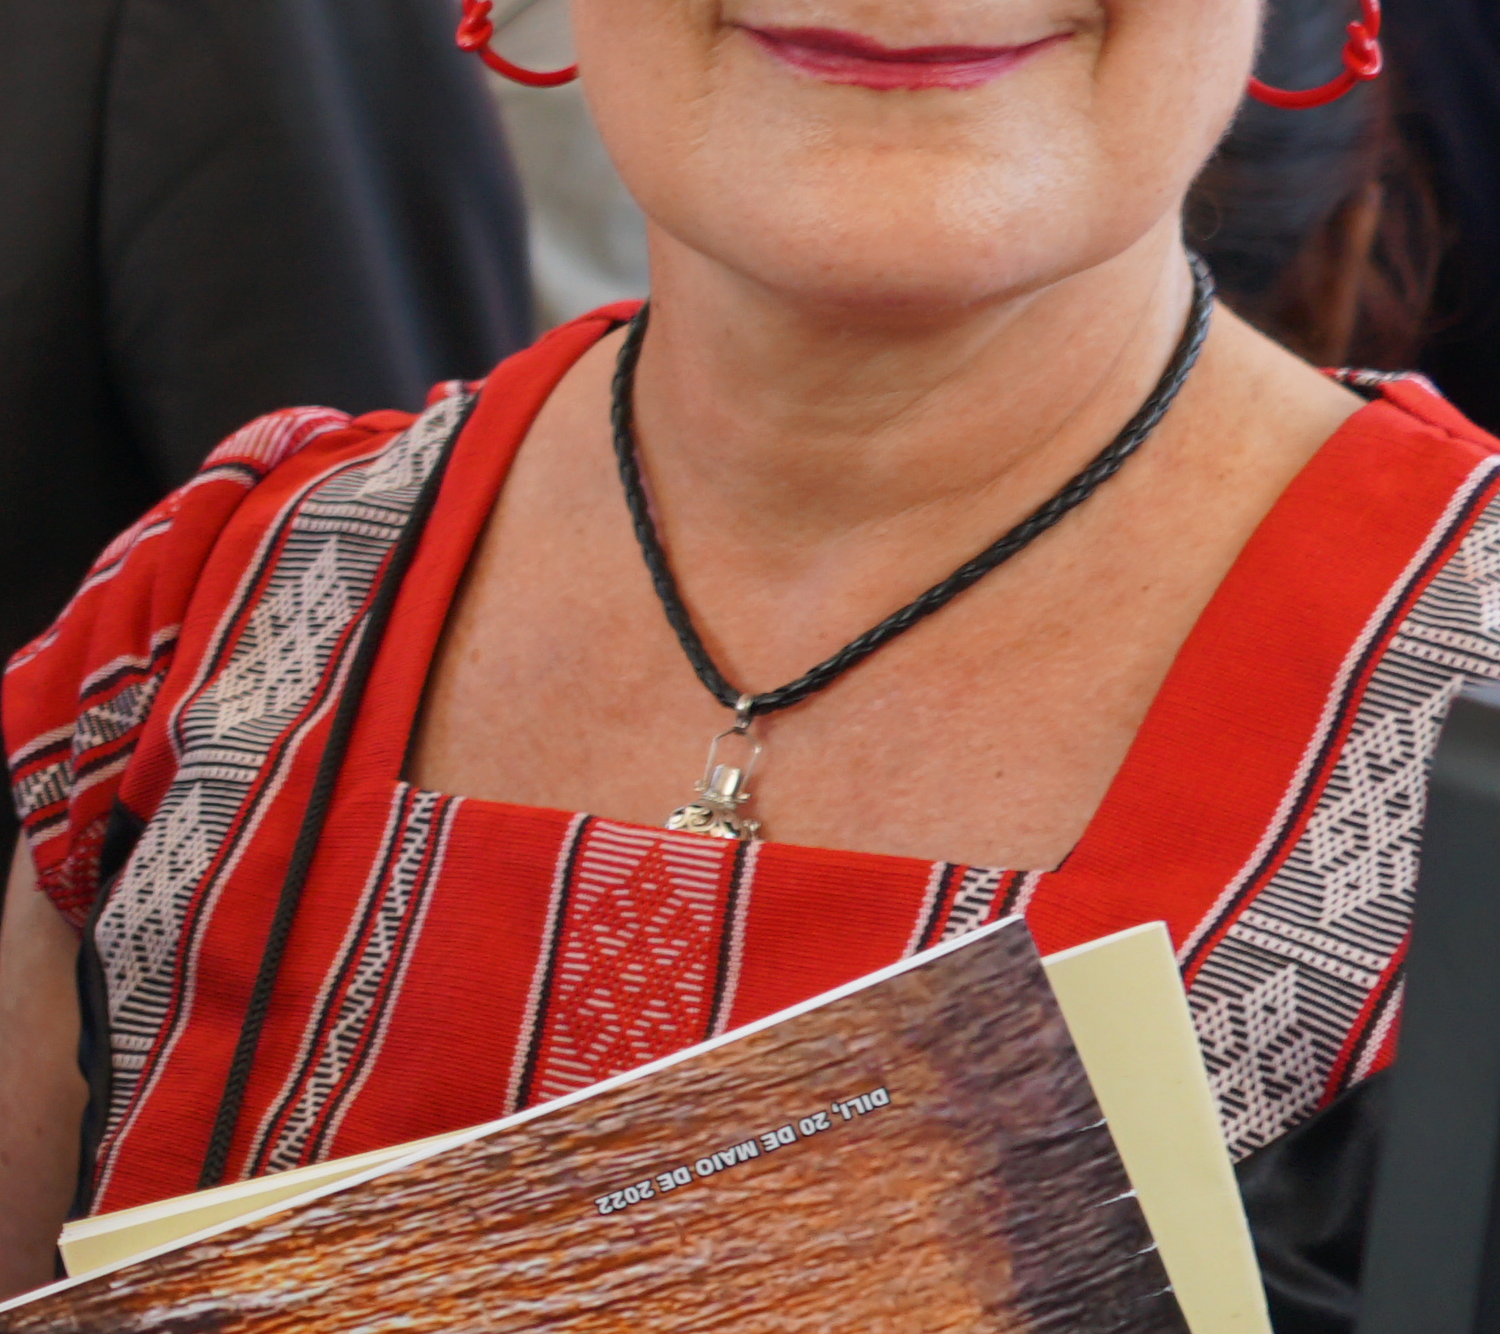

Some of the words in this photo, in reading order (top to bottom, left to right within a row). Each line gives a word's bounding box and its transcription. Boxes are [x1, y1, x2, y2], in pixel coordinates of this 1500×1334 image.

[831, 1086, 891, 1121] DILI,
[760, 1125, 798, 1153] DE
[799, 1111, 831, 1137] 20
[694, 1139, 760, 1177] MAIO
[656, 1166, 693, 1193] DE
[594, 1179, 655, 1215] 2022
